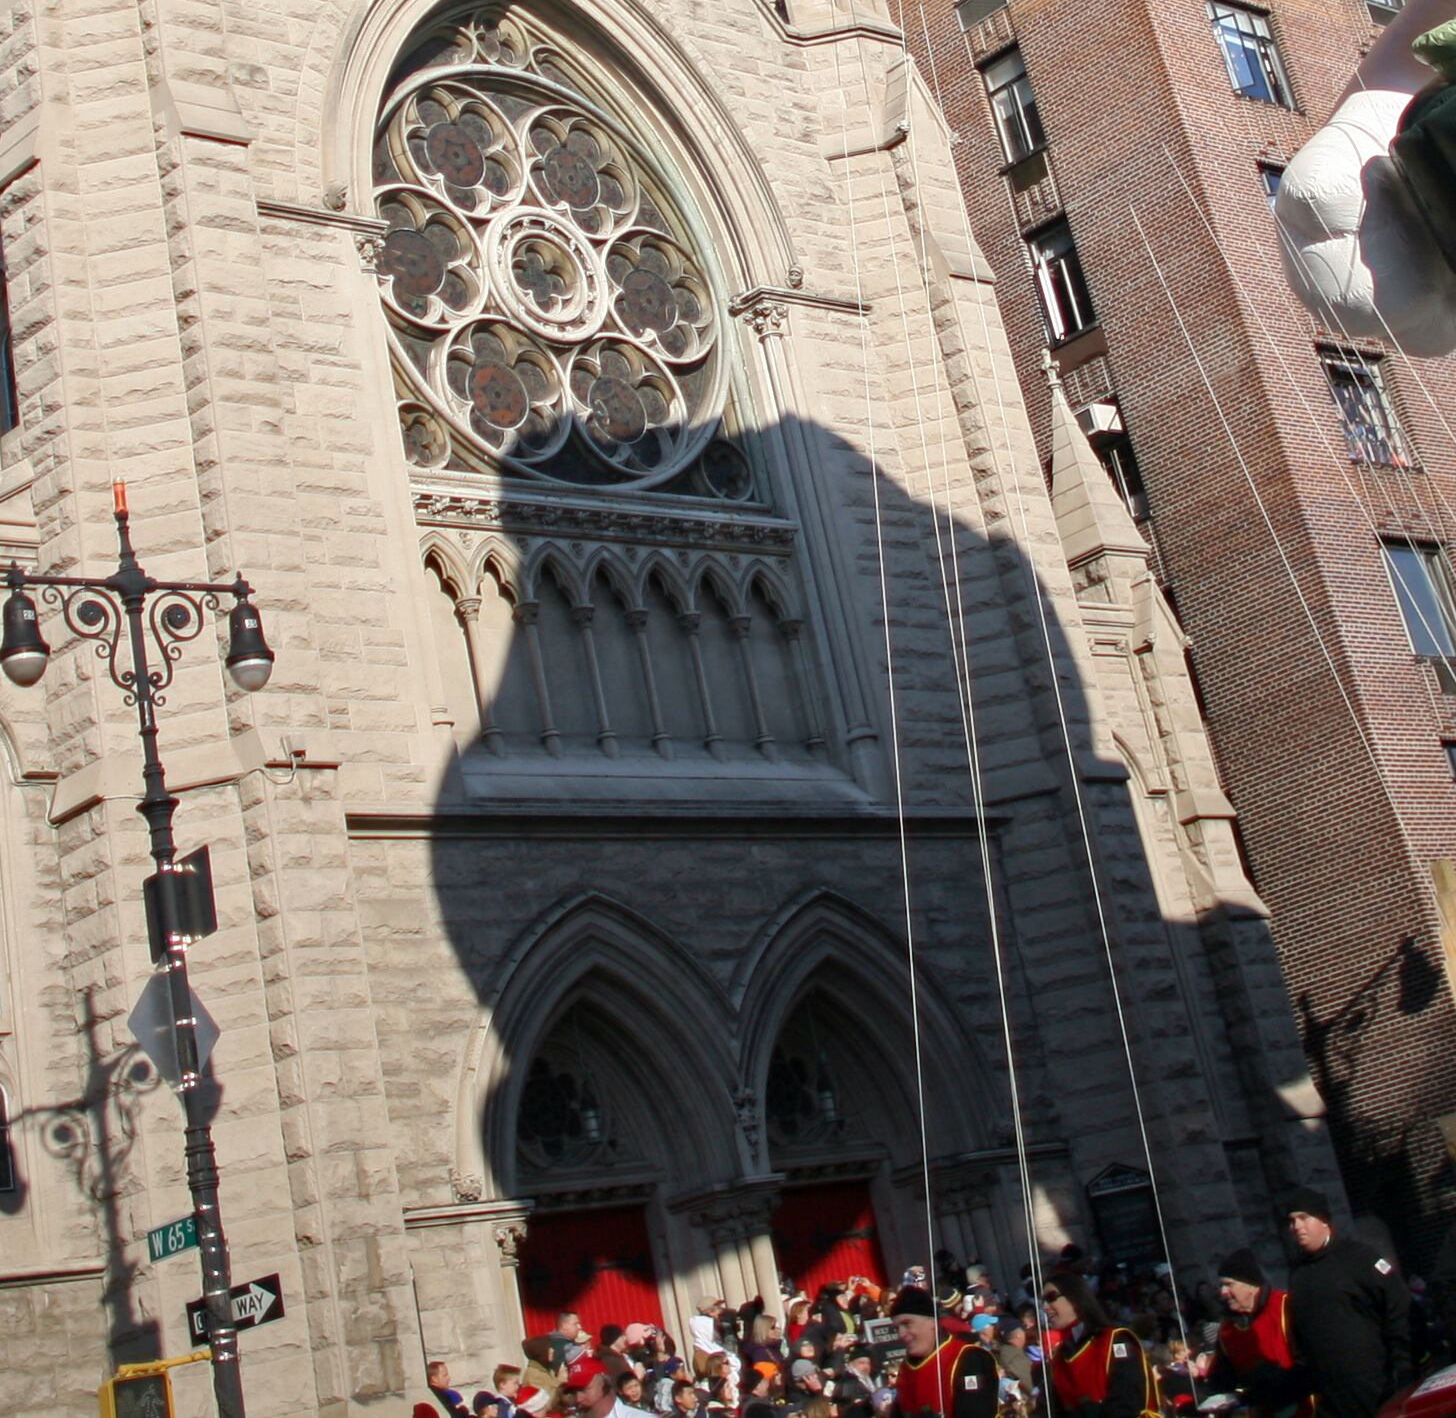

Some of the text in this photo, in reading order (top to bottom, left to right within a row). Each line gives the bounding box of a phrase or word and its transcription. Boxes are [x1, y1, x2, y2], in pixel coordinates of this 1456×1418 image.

[152, 1219, 195, 1257] W 65 S
[236, 1292, 264, 1317] WAY
